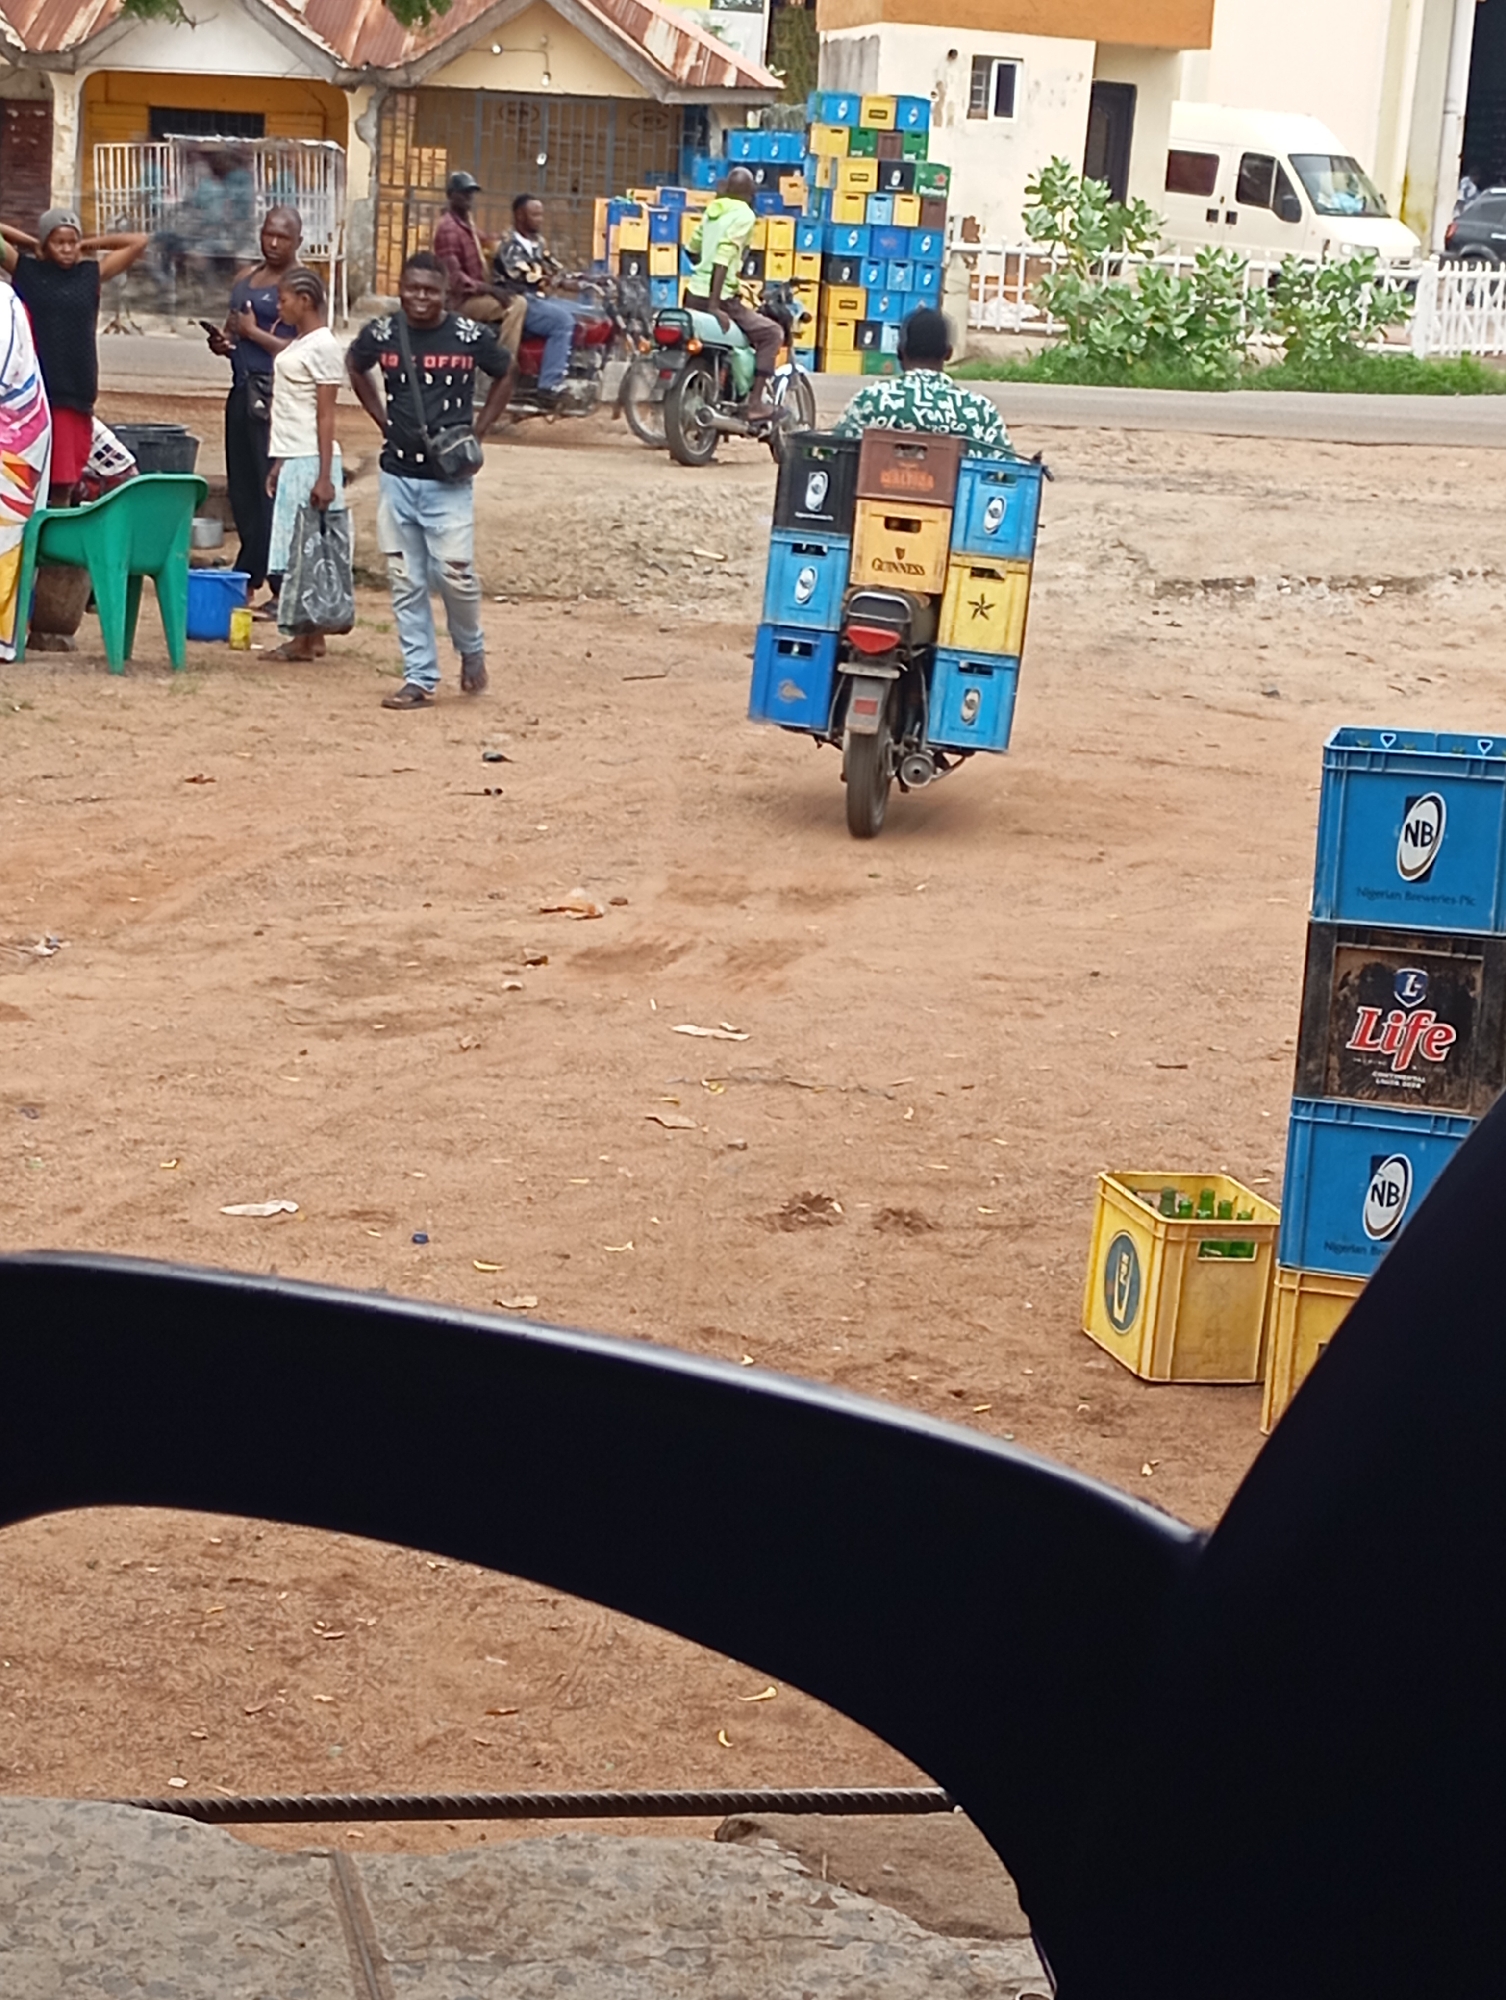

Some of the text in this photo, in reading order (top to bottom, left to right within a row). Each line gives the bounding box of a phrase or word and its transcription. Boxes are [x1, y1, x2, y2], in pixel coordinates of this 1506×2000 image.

[1404, 819, 1434, 848] NB
[1356, 886, 1402, 901] Nigerian
[1405, 890, 1456, 905] Breweries
[1345, 1005, 1457, 1072] Life
[1370, 1180, 1400, 1209] NB
